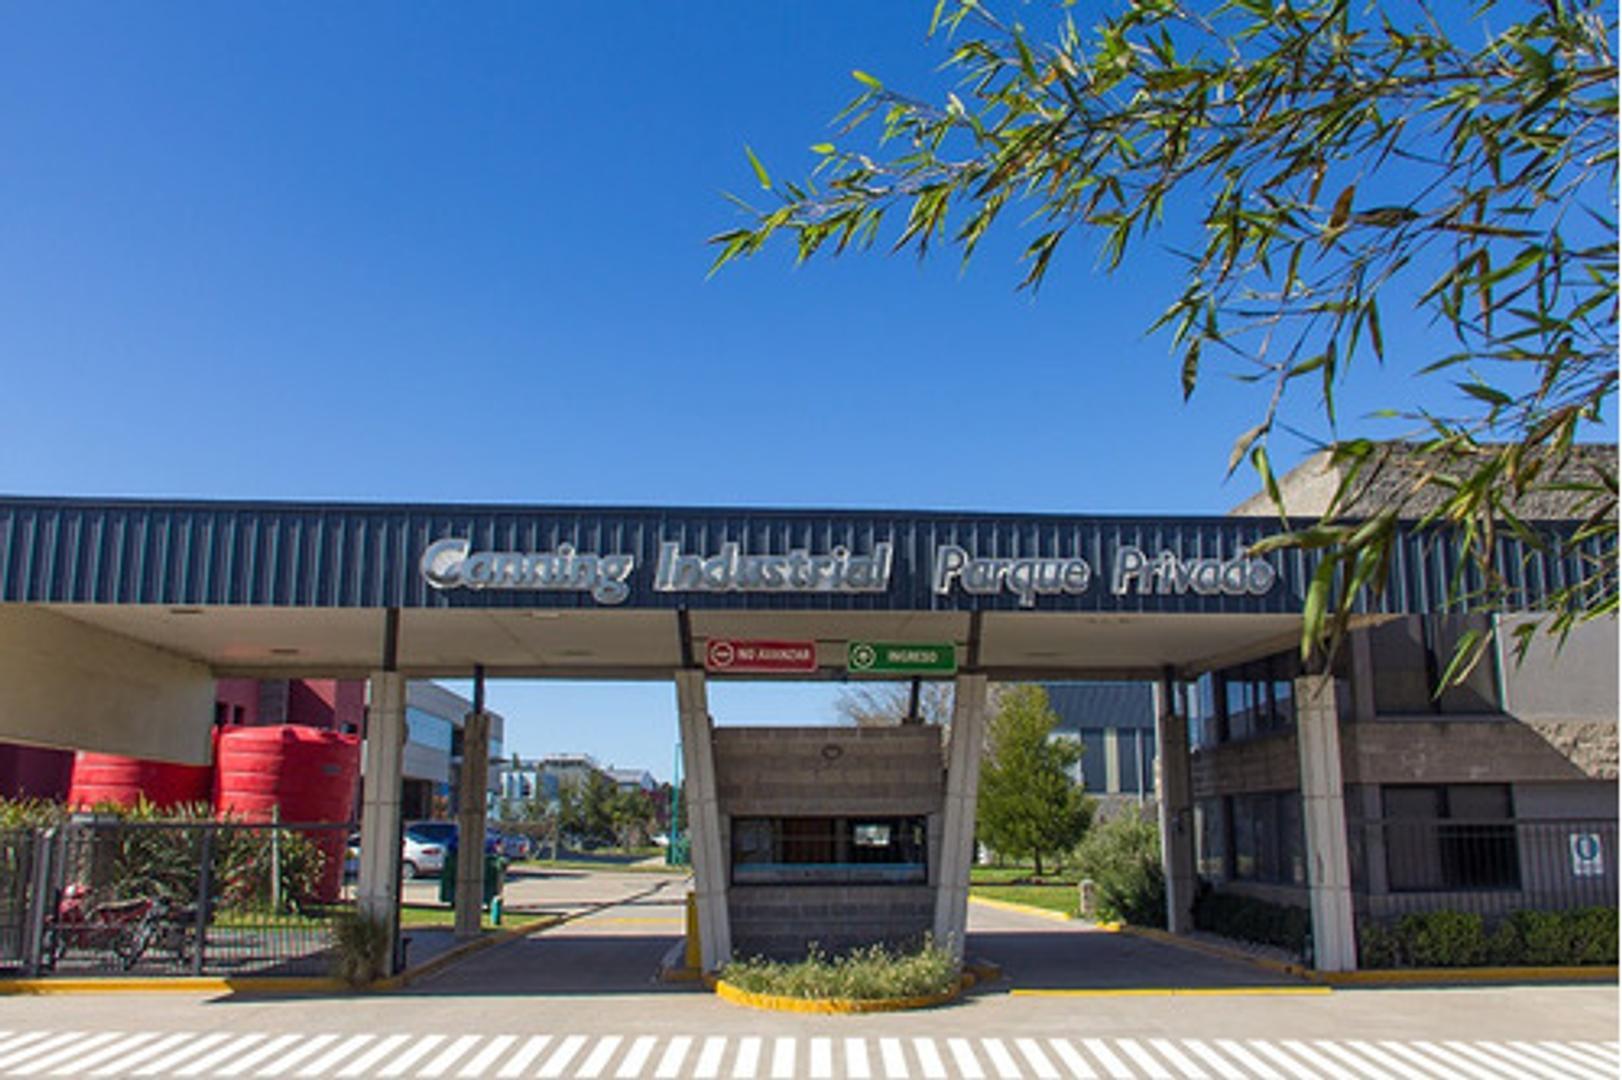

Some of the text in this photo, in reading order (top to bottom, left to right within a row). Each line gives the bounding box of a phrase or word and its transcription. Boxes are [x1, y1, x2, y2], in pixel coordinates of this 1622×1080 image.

[420, 537, 1276, 607] Canning Industrial Parque Privado
[737, 648, 811, 661] NO AVANZAR
[887, 650, 939, 663] INGRESO
